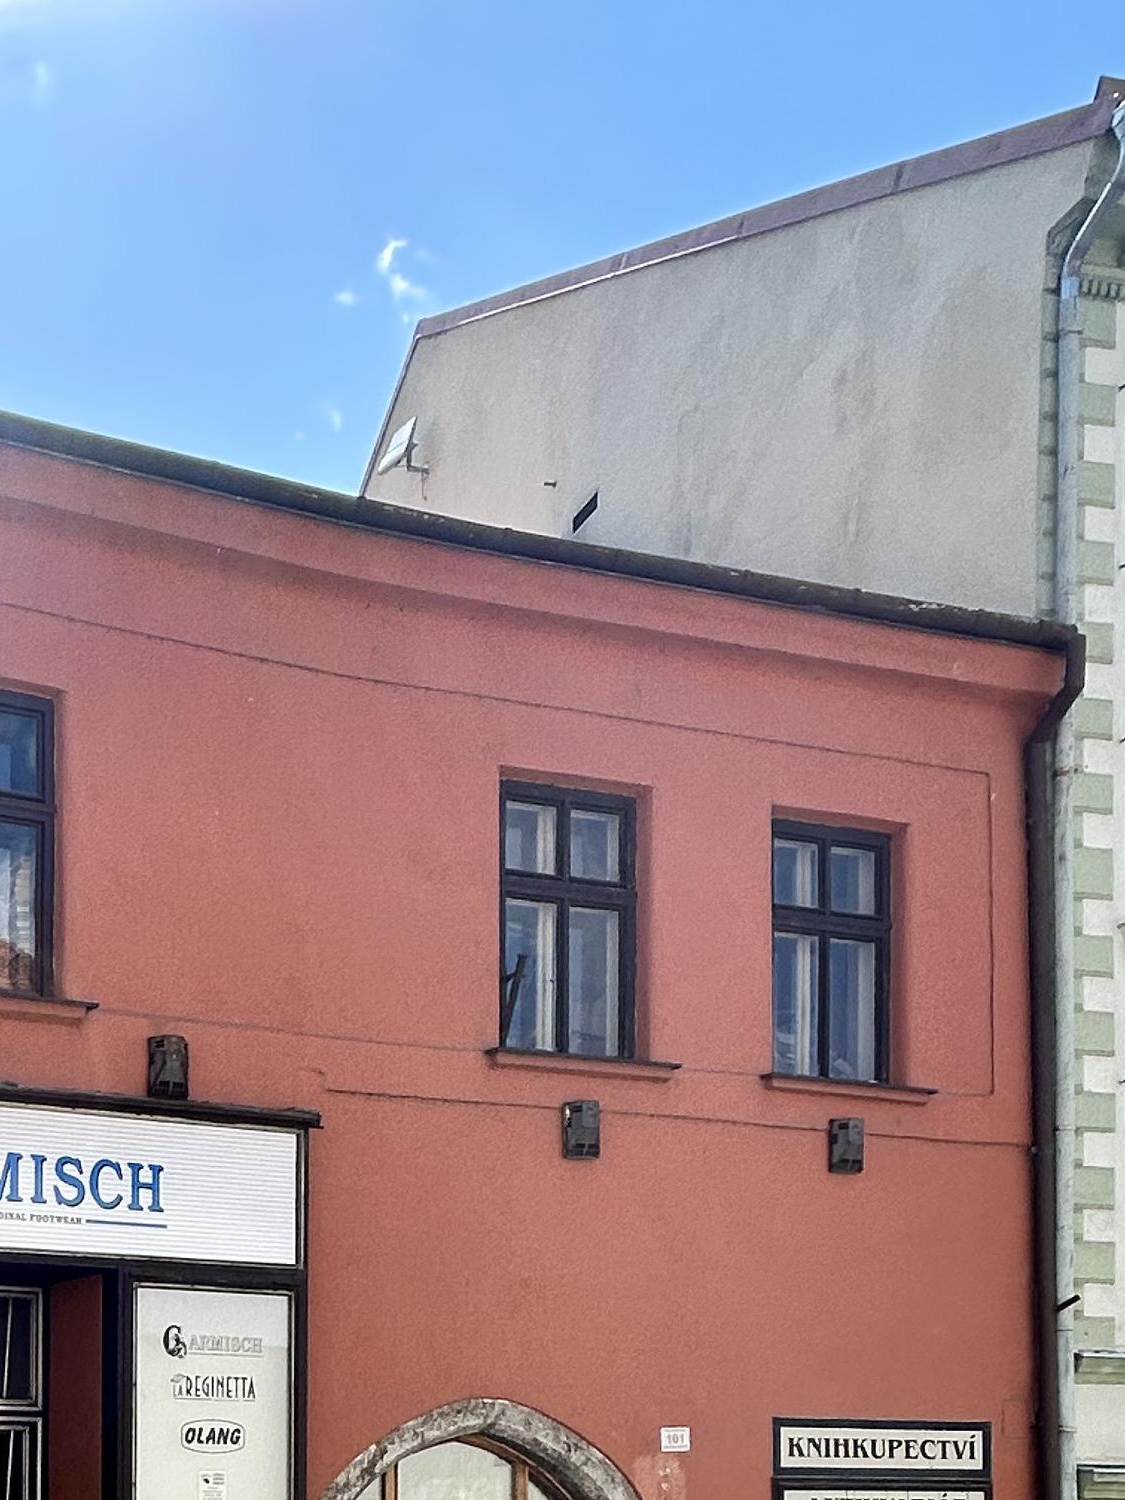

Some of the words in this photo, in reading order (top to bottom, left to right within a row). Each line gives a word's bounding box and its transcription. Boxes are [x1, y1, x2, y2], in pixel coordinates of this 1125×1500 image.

[29, 1213, 82, 1225] FOOTWEAR
[186, 1375, 256, 1398] REGINETTA
[184, 1426, 241, 1445] OLANG
[666, 1433, 684, 1445] 101
[787, 1434, 977, 1461] KNIHKUPECTVÍ
